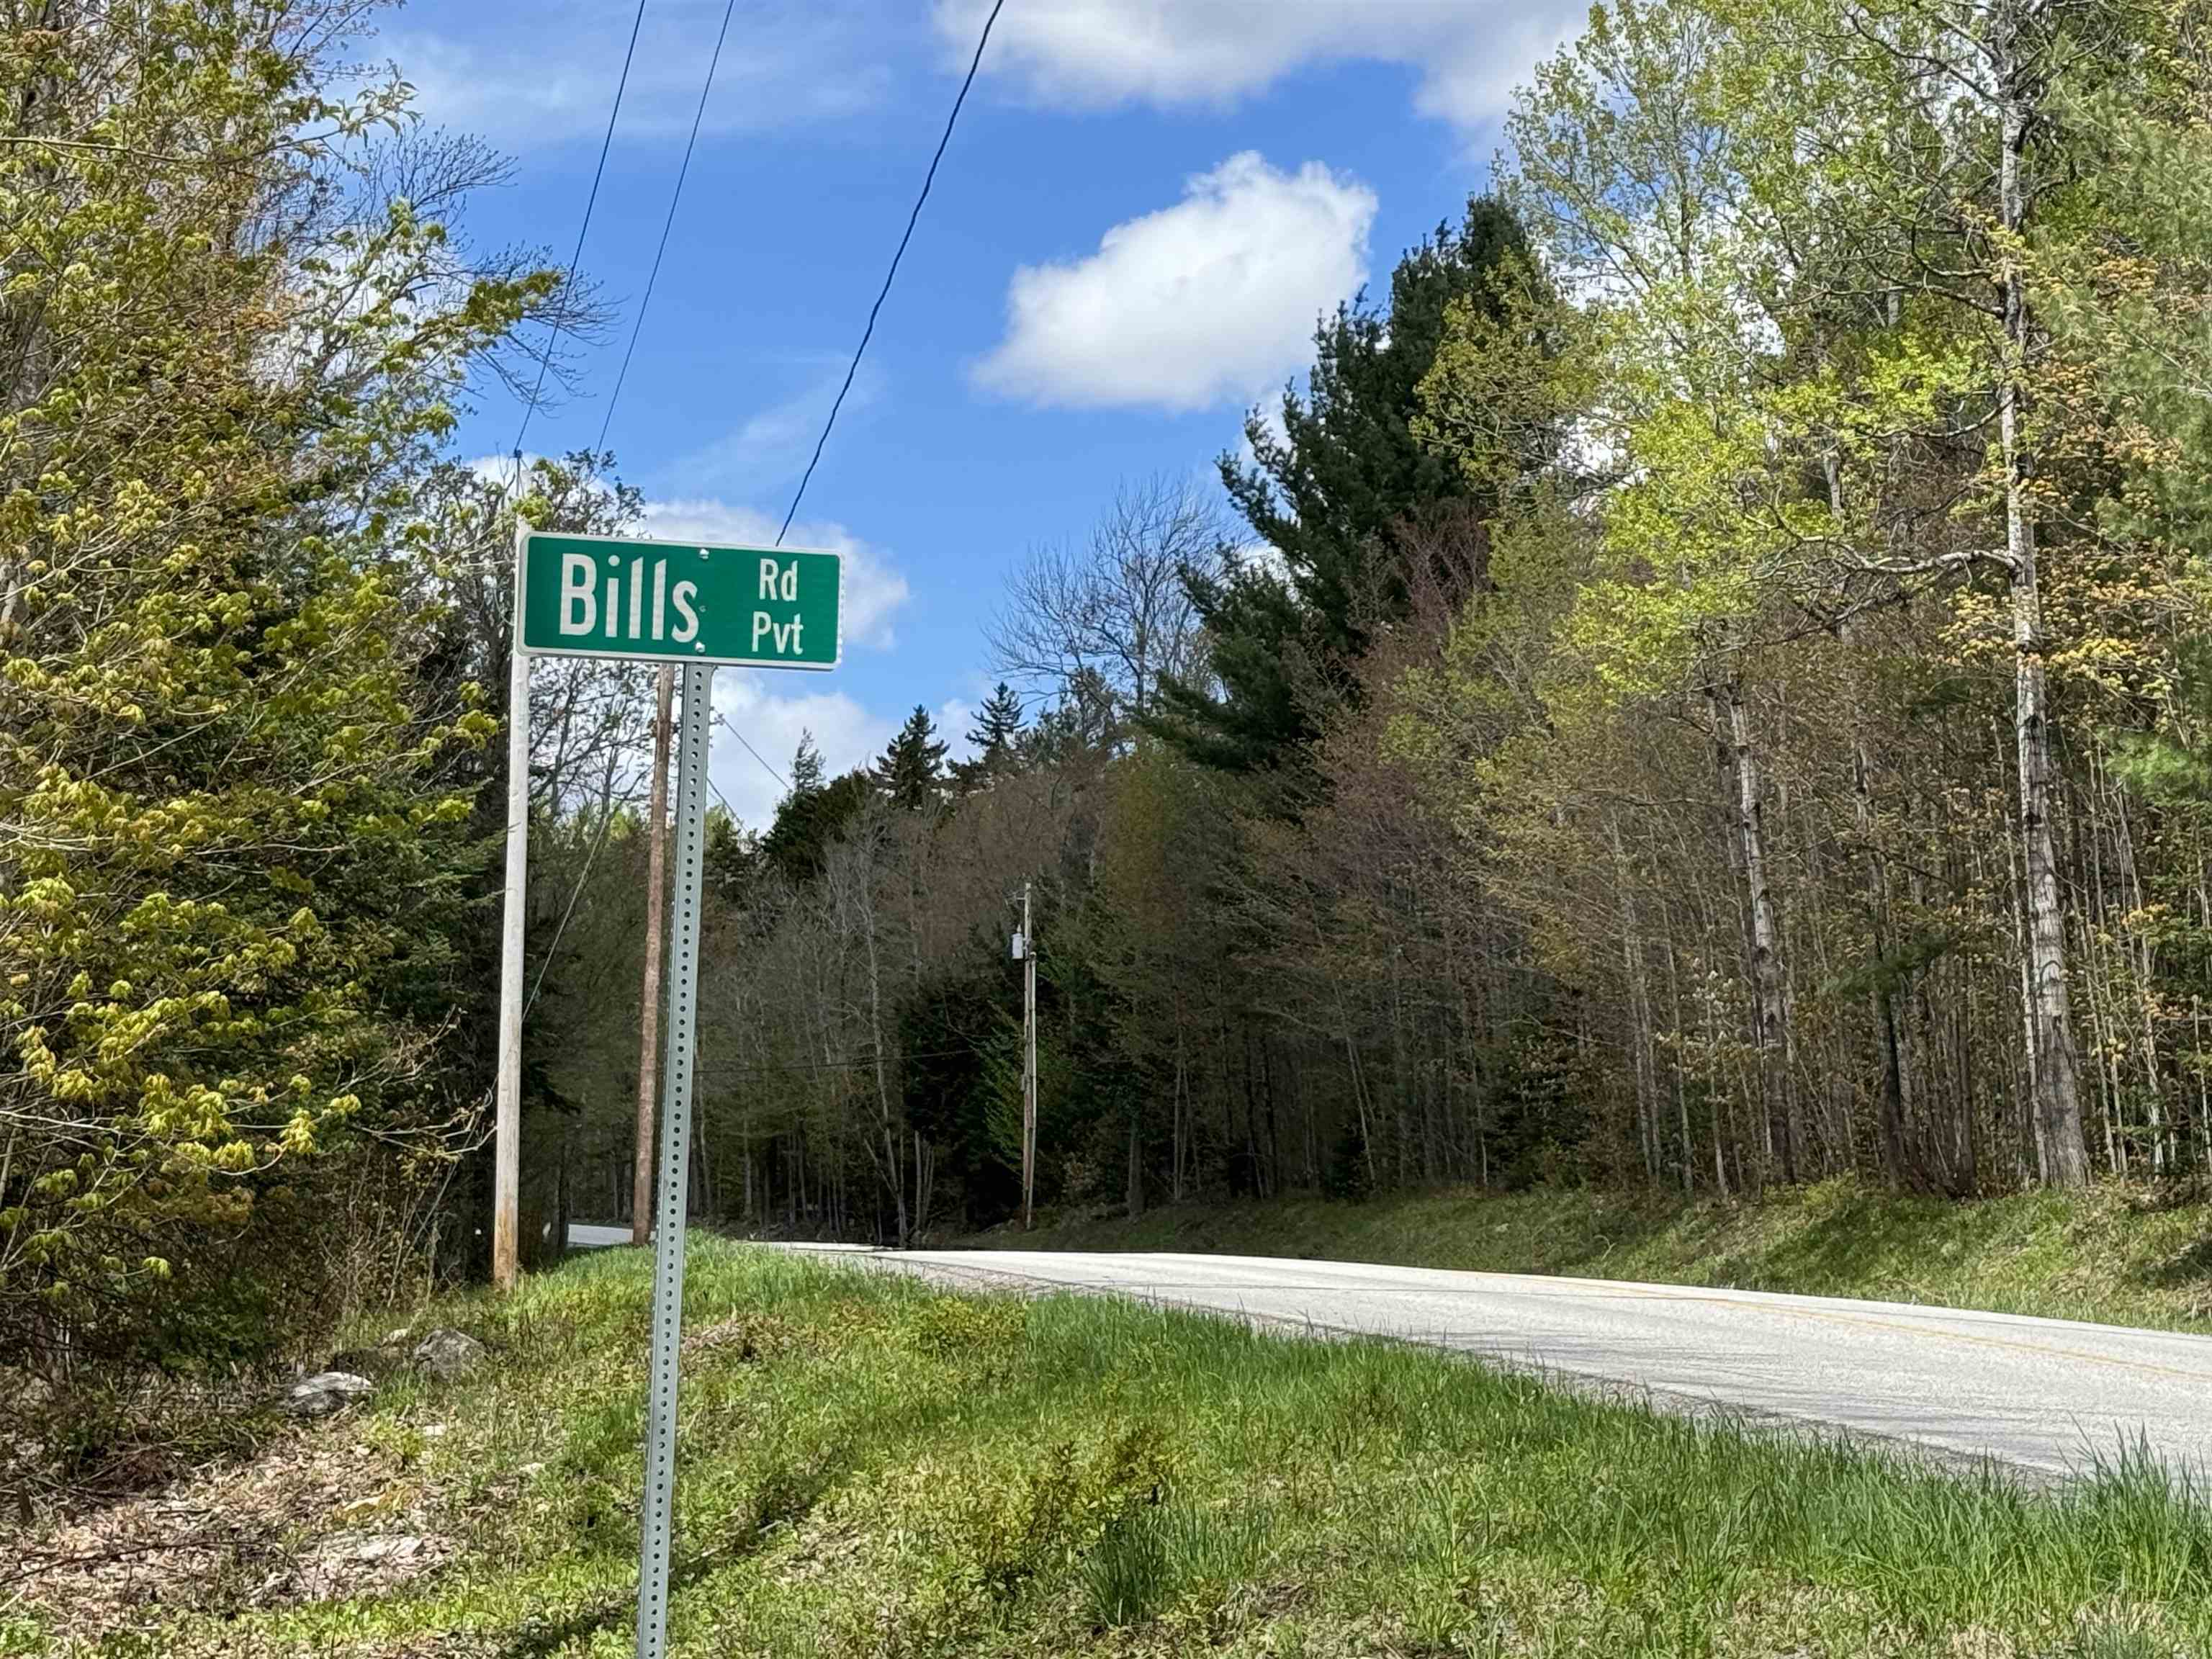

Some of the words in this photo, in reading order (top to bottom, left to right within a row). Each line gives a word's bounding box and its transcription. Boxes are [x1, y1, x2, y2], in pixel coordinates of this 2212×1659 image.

[559, 553, 700, 643] Bills
[758, 558, 799, 602] Rd
[752, 611, 804, 655] Pvt
